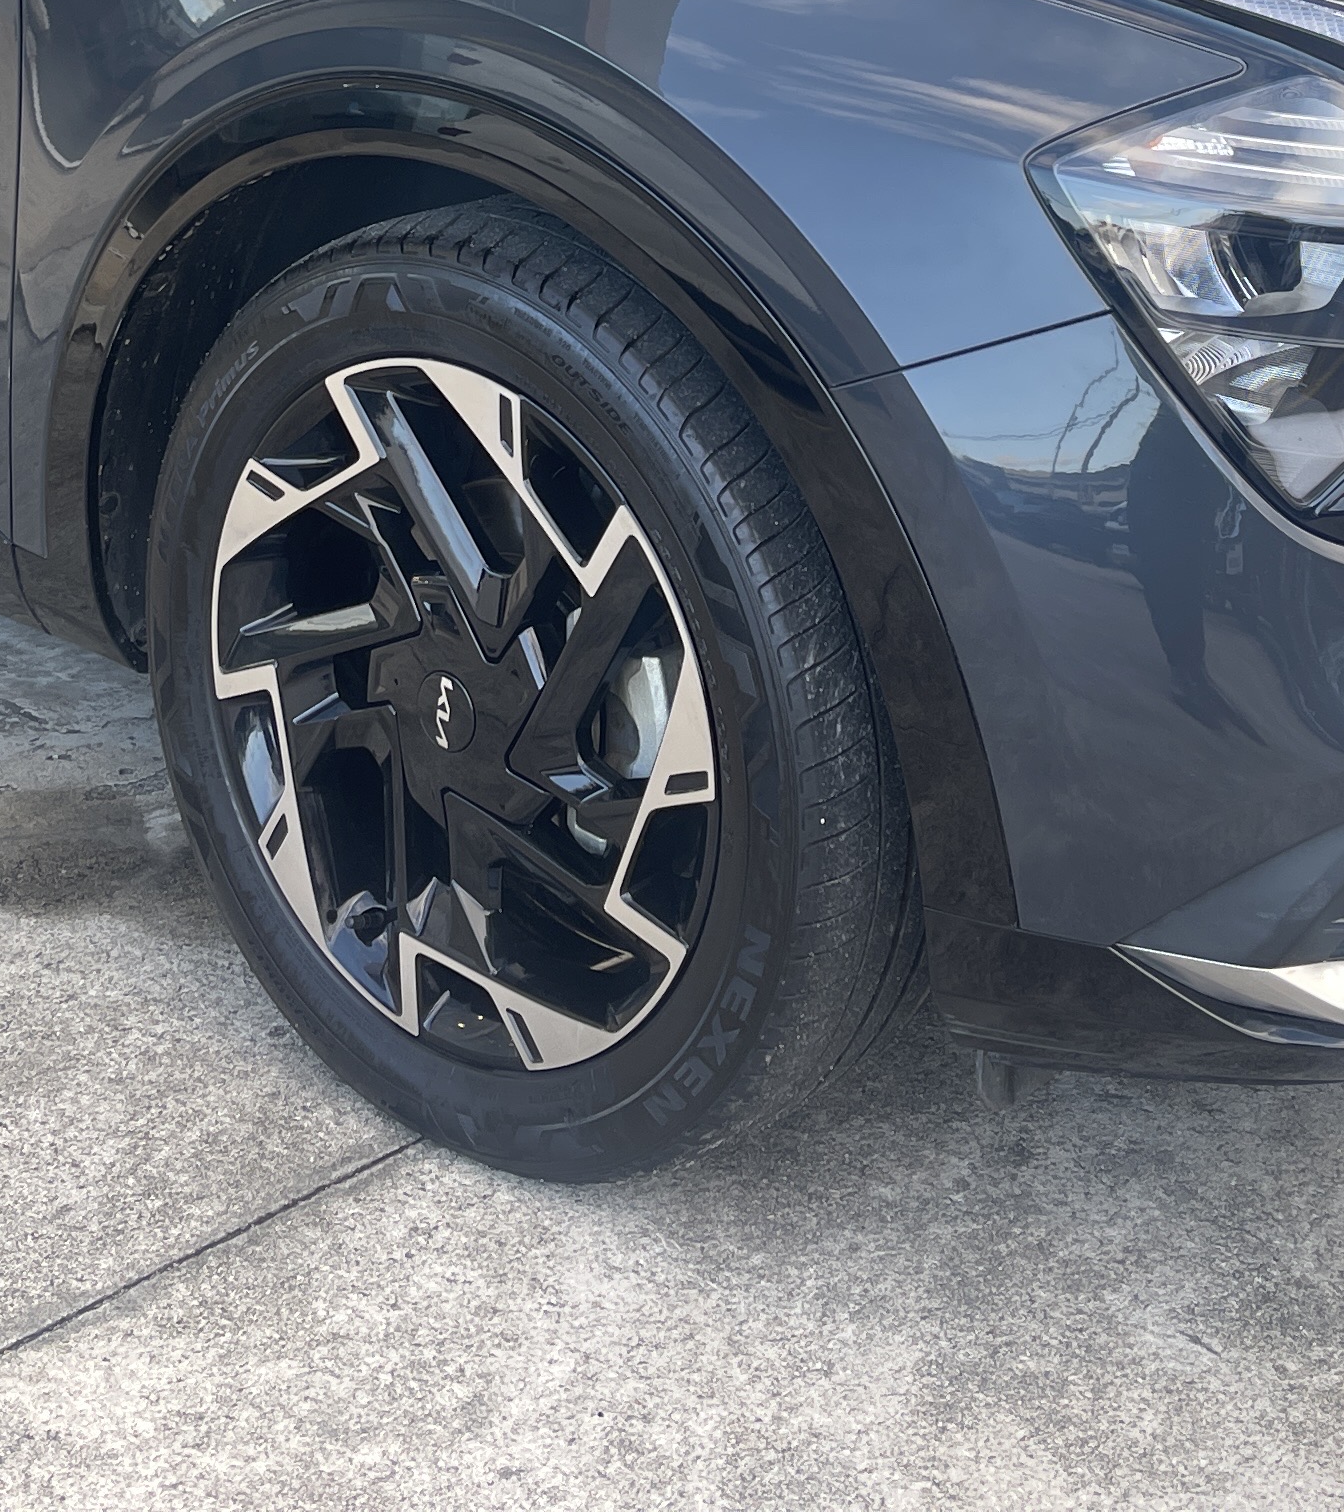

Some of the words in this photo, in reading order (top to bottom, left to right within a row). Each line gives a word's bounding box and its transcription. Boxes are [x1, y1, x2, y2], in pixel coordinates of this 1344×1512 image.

[551, 354, 633, 436] OUTSIDE
[436, 676, 454, 750] KIA
[643, 924, 771, 1126] NEXEN
